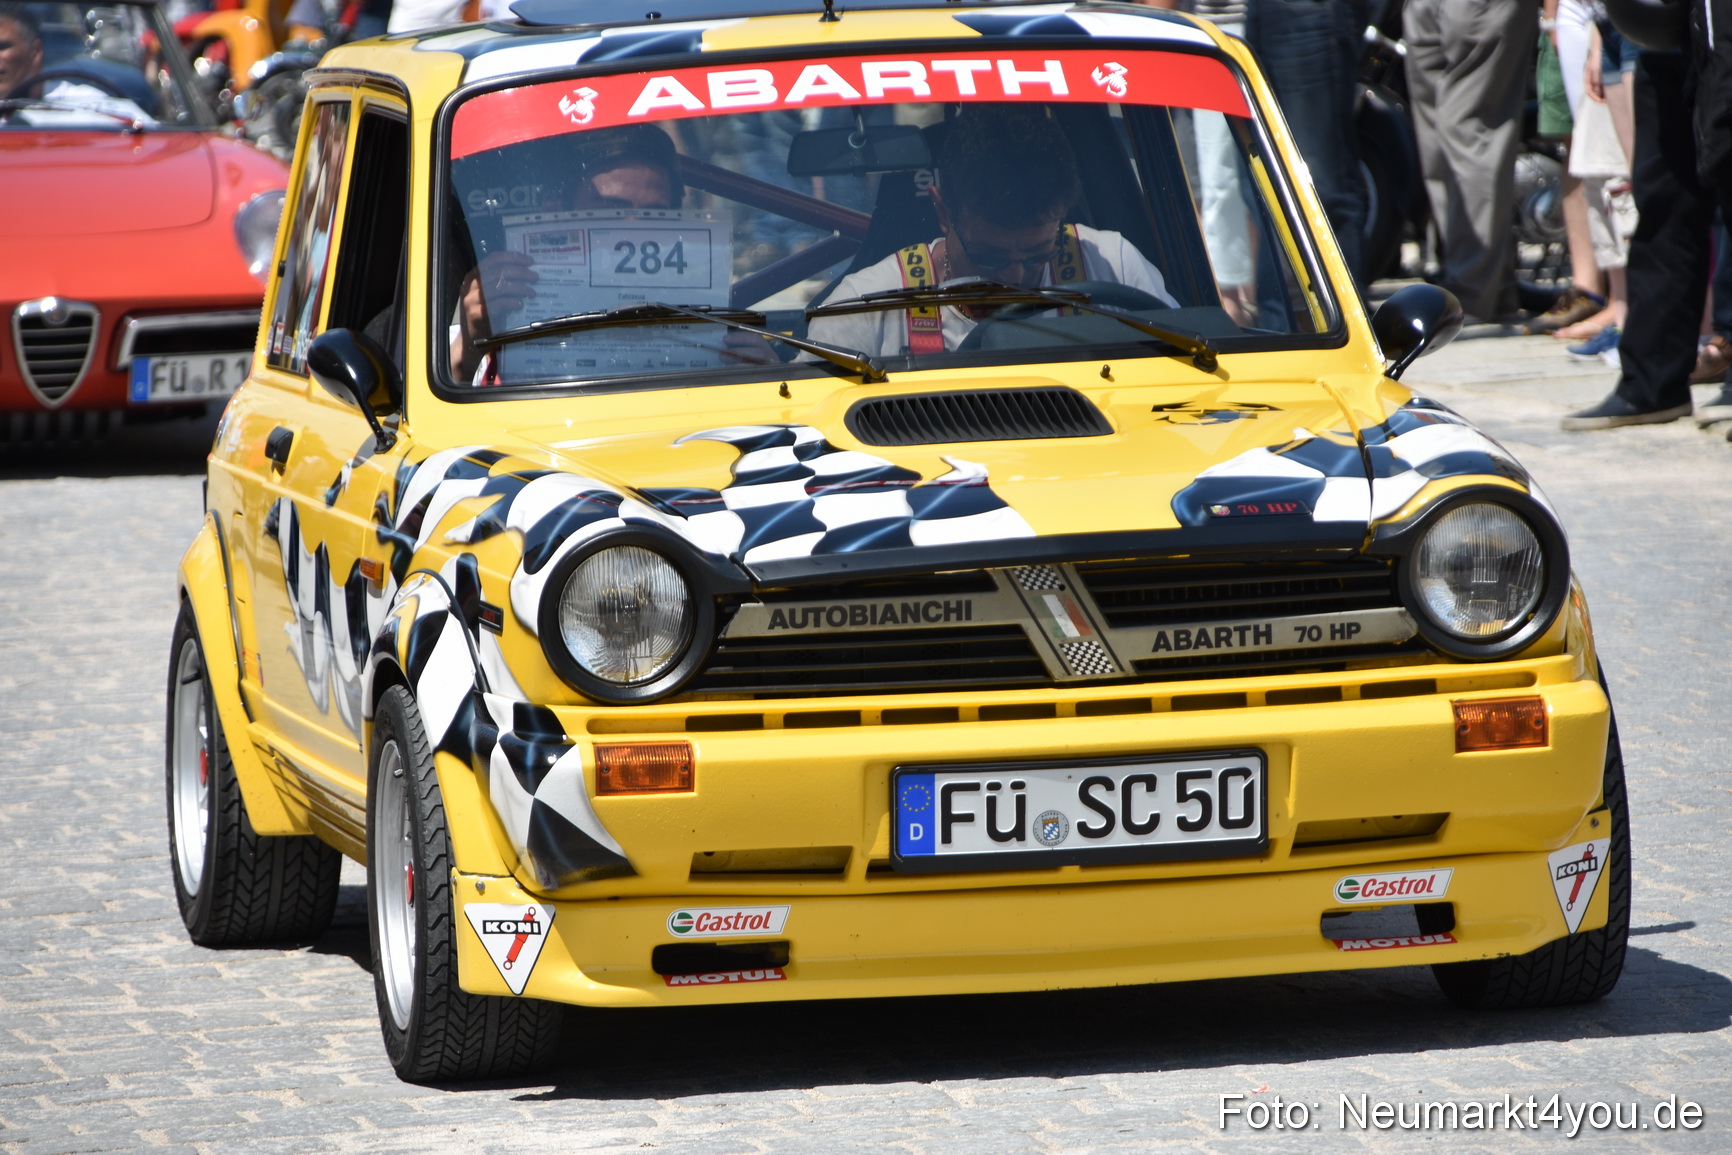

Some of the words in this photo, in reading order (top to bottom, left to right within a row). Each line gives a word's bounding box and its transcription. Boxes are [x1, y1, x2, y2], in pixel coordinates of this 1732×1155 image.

[627, 59, 1070, 117] ABARTH
[614, 240, 687, 275] 284
[151, 361, 189, 394] FÜ
[209, 359, 226, 391] R
[1237, 504, 1260, 514] 70
[1266, 503, 1297, 513] HP
[767, 600, 973, 630] AUTOBIANCHI
[1152, 623, 1273, 652] ABARTH
[1294, 625, 1323, 643] 70
[1330, 622, 1361, 641] HP
[940, 779, 1027, 845] FÜ
[1076, 773, 1161, 839] SC
[1175, 767, 1255, 832] 50
[909, 823, 924, 841] D
[1557, 858, 1596, 879] KONI
[1361, 874, 1436, 898] Castrol
[485, 921, 539, 933] KONI
[695, 910, 772, 932] Castrol
[1341, 933, 1452, 950] MOTUL
[670, 969, 782, 985] MOTUL
